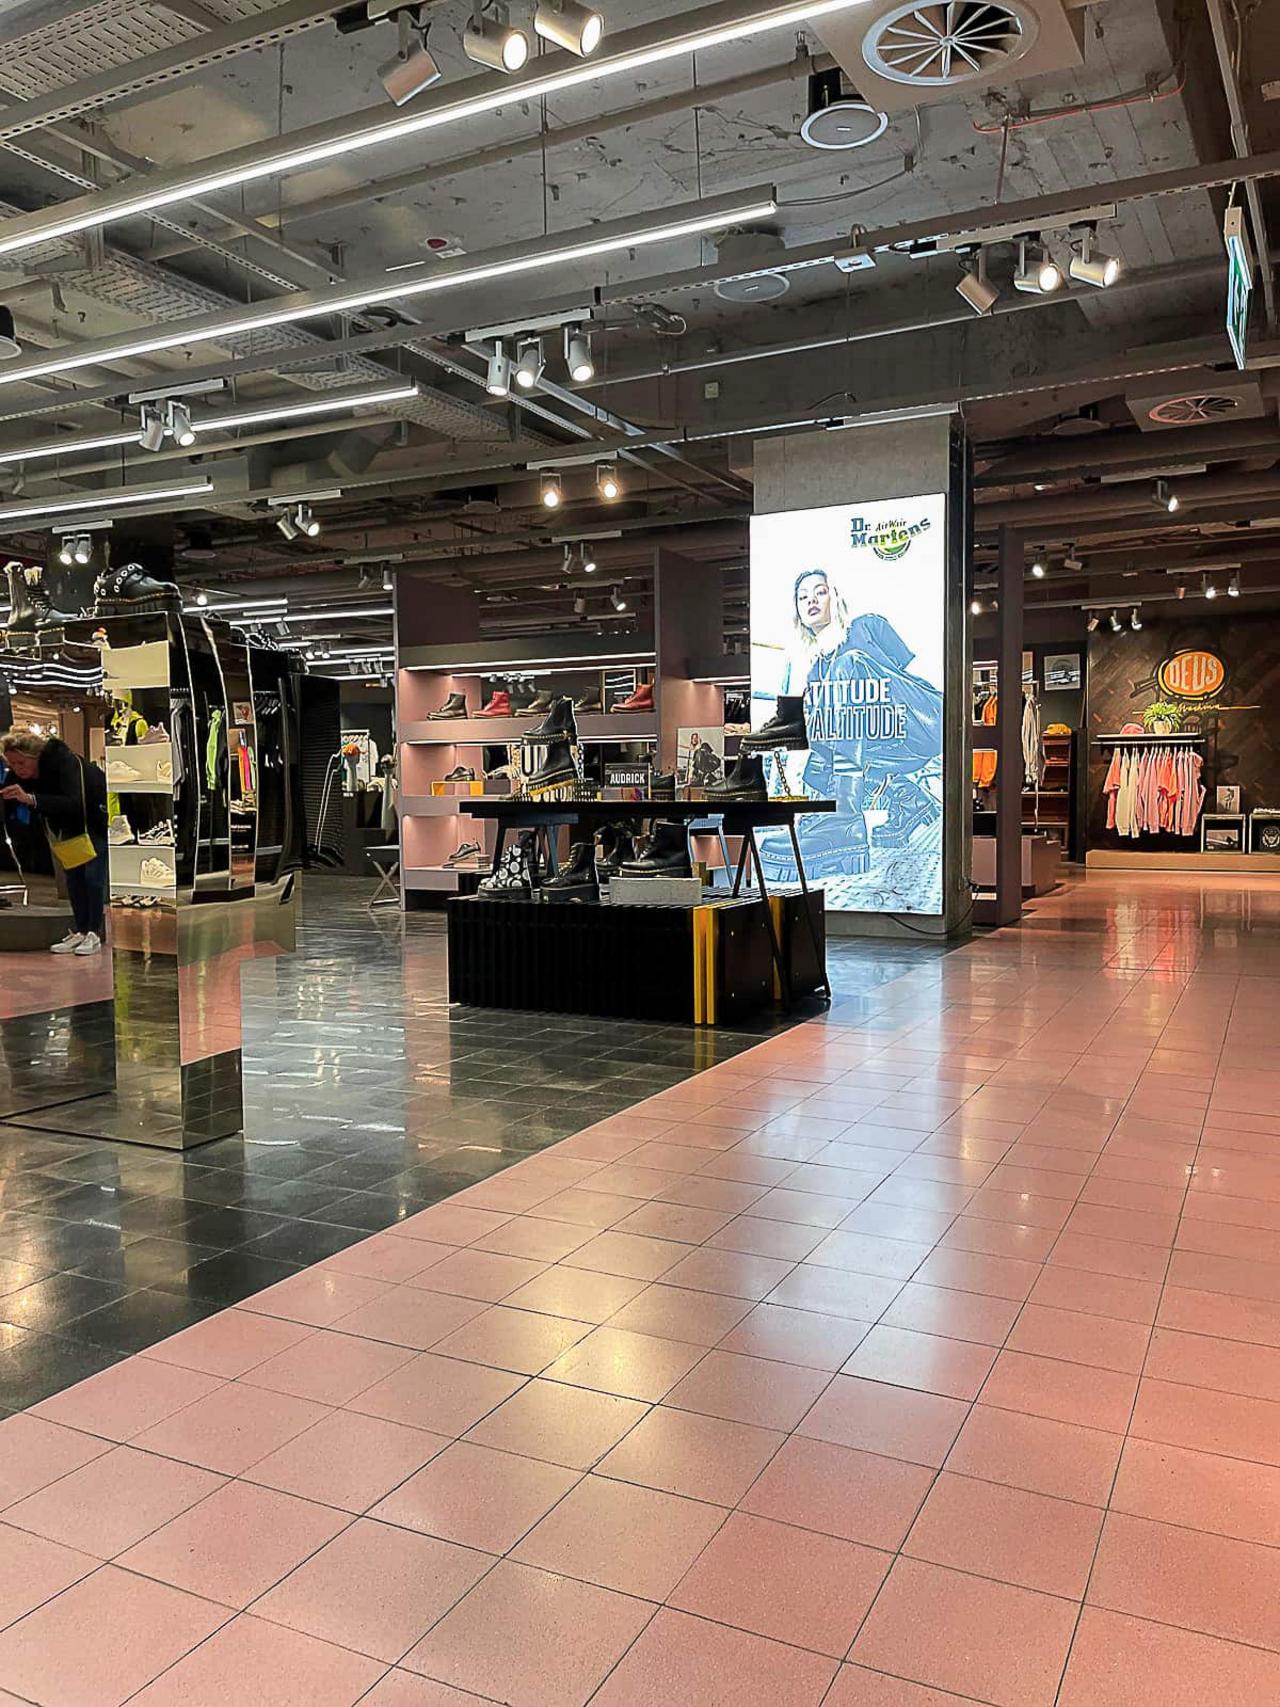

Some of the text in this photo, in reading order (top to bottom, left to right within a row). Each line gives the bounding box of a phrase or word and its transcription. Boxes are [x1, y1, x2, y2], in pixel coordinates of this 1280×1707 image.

[850, 517, 871, 532] Dr.
[850, 518, 931, 548] Martens
[1168, 655, 1218, 691] DEUS
[810, 703, 908, 741] ALTITUDE
[609, 772, 646, 784] AUDRICK
